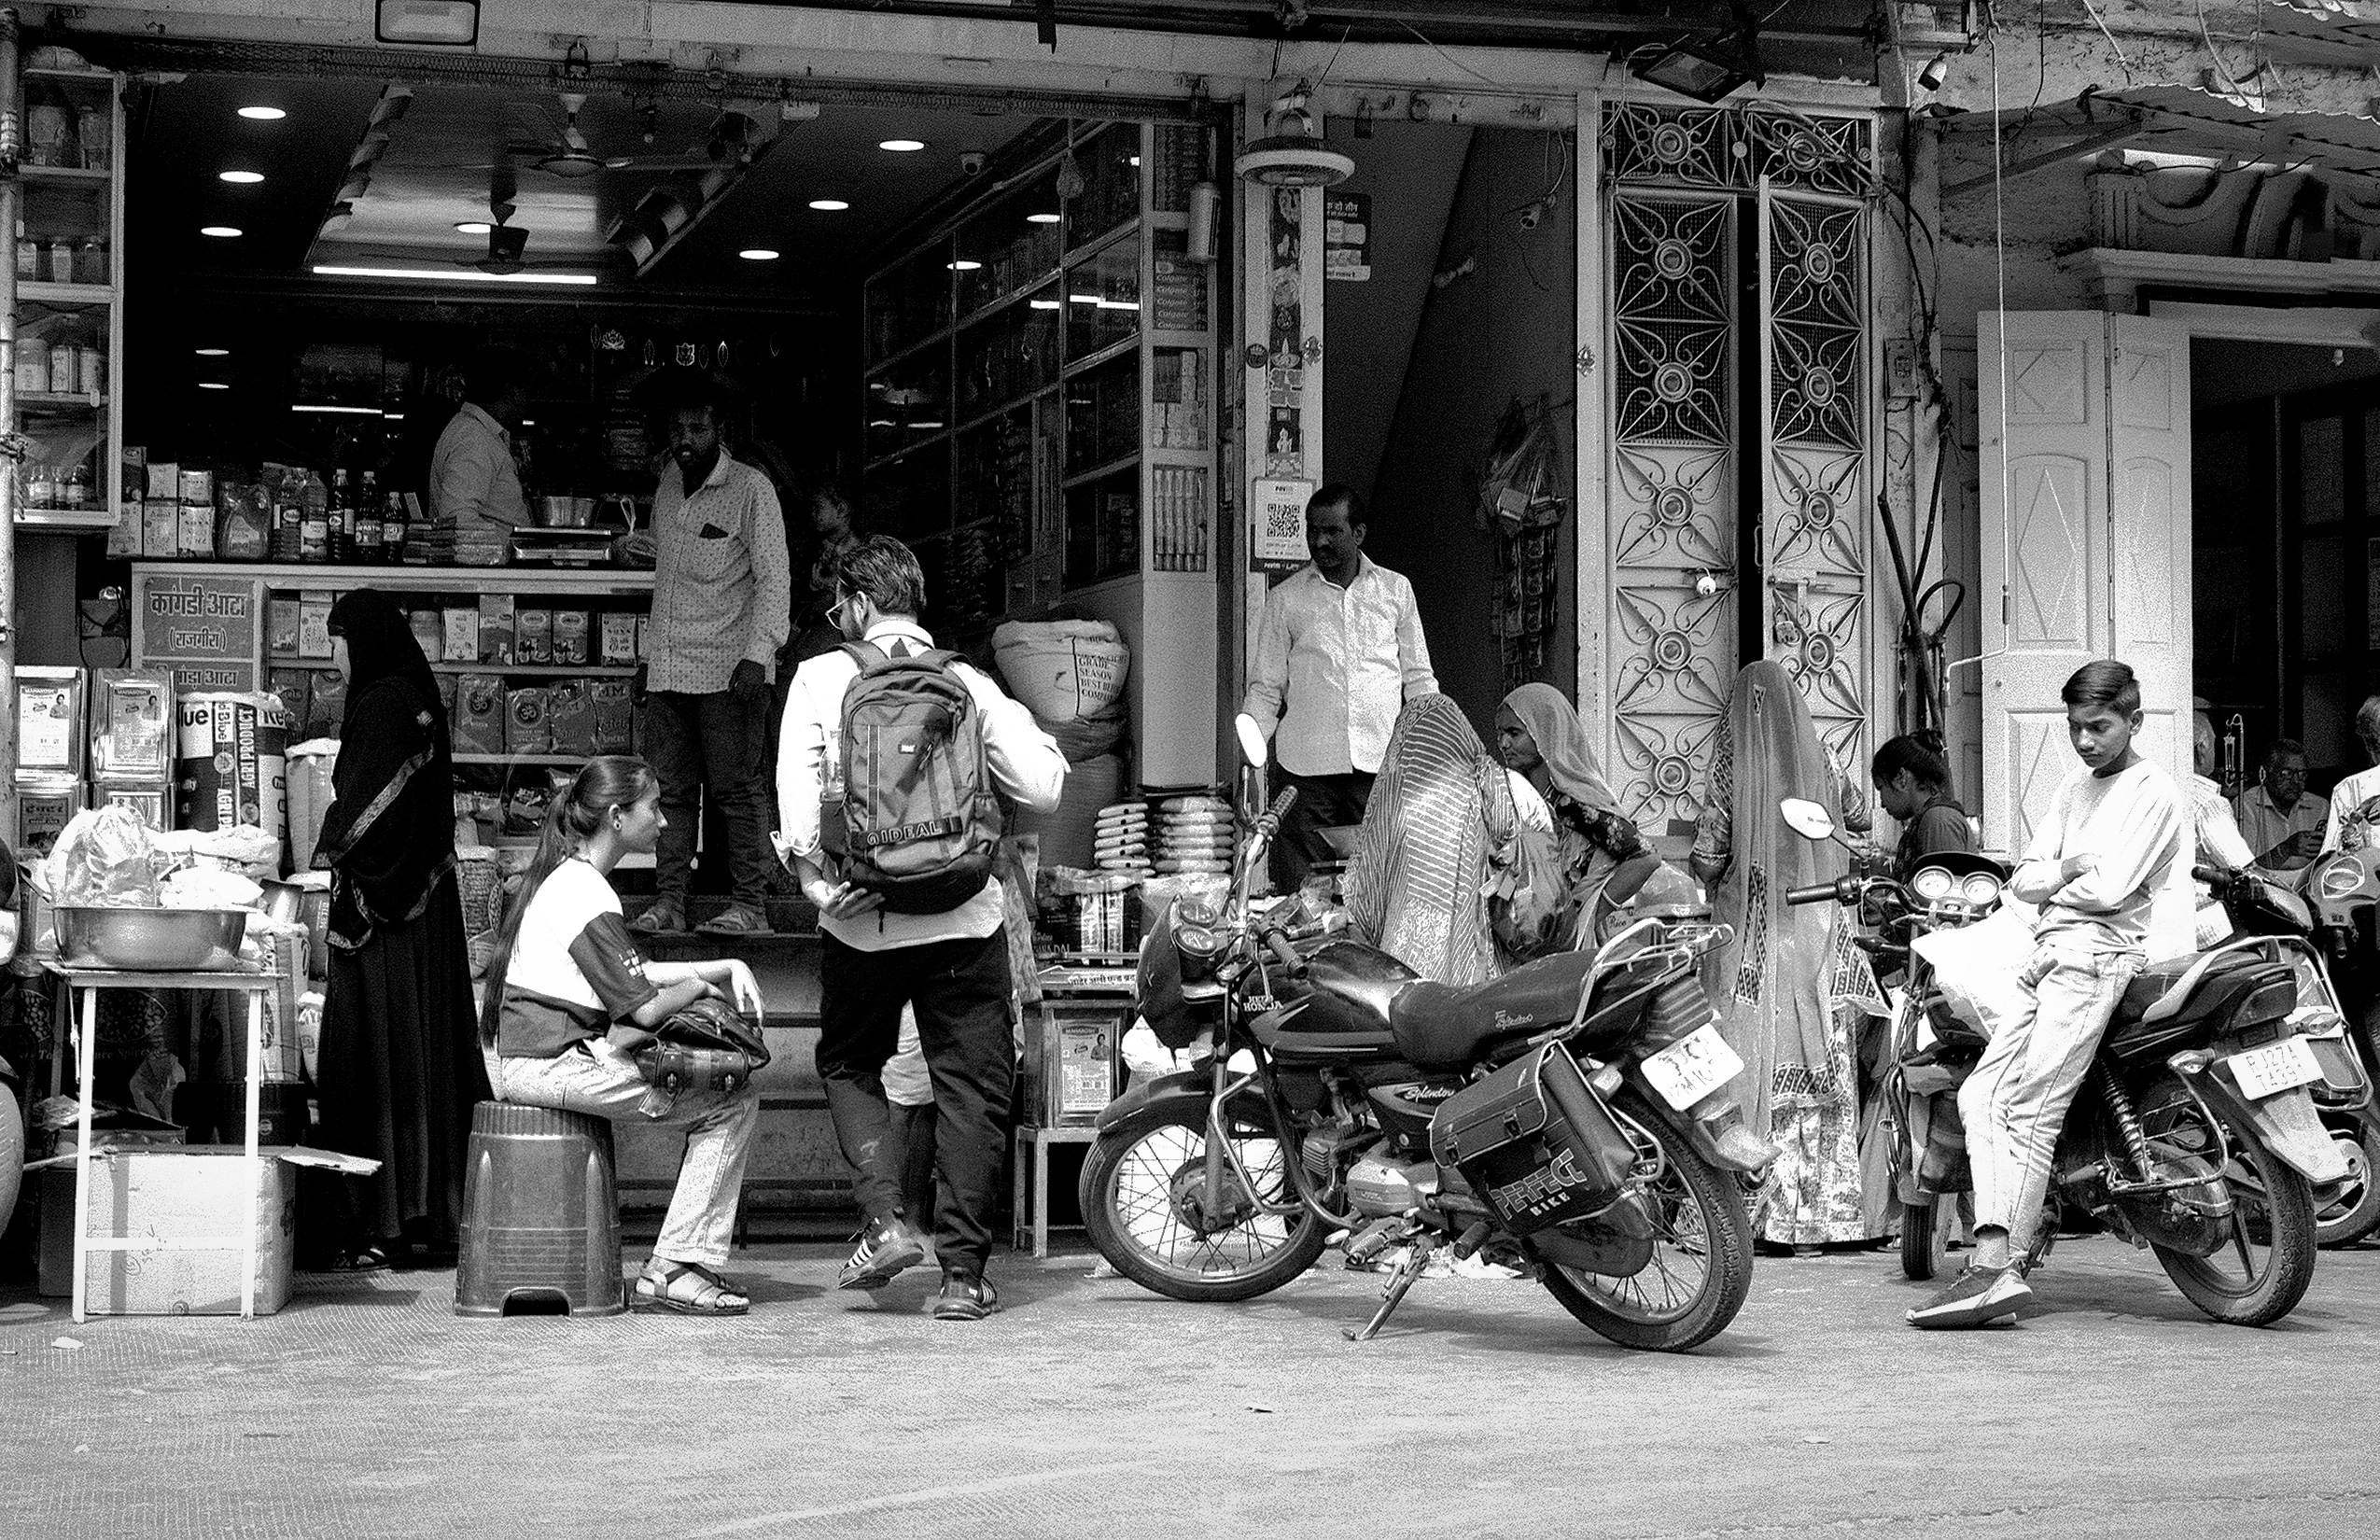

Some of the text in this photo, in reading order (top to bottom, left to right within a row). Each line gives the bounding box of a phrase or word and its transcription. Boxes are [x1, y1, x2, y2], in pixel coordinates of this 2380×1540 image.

[205, 591, 248, 618] आटा
[168, 626, 228, 652] (राजगीरा)
[1079, 657, 1110, 670] GRADE
[1079, 667, 1113, 681] SEASON
[204, 668, 239, 687] आटा
[1081, 679, 1101, 690] BEST
[239, 708, 256, 789] AGRI PRODUCT
[1243, 1001, 1284, 1012] HONDA
[2245, 1044, 2300, 1073] RJ27A
[1489, 1147, 1588, 1221] PERFECT
[1529, 1192, 1571, 1216] BIKE
